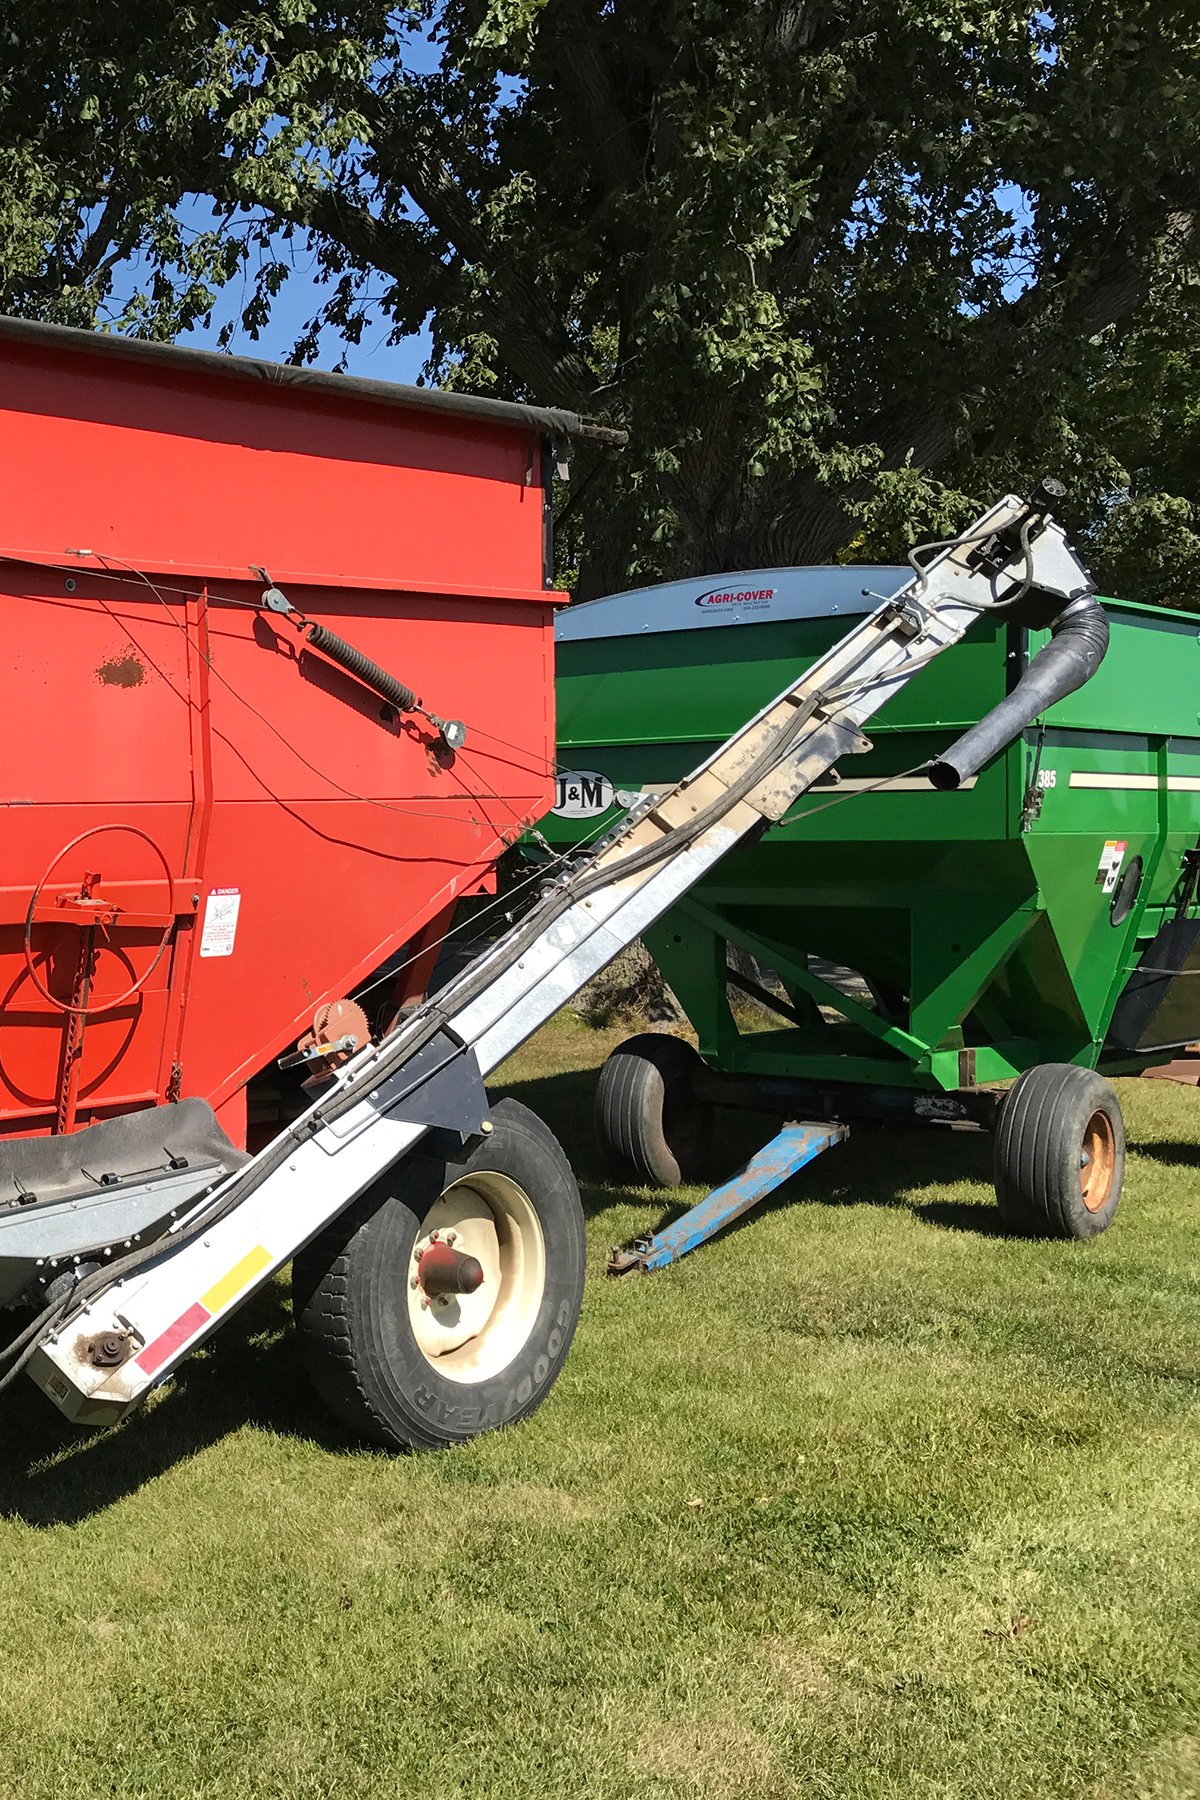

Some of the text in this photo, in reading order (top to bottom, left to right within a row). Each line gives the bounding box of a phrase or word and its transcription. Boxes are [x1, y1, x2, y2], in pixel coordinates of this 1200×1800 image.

[707, 589, 773, 604] AGRI-COVER
[1038, 770, 1056, 788] 385
[554, 776, 604, 810] J&M
